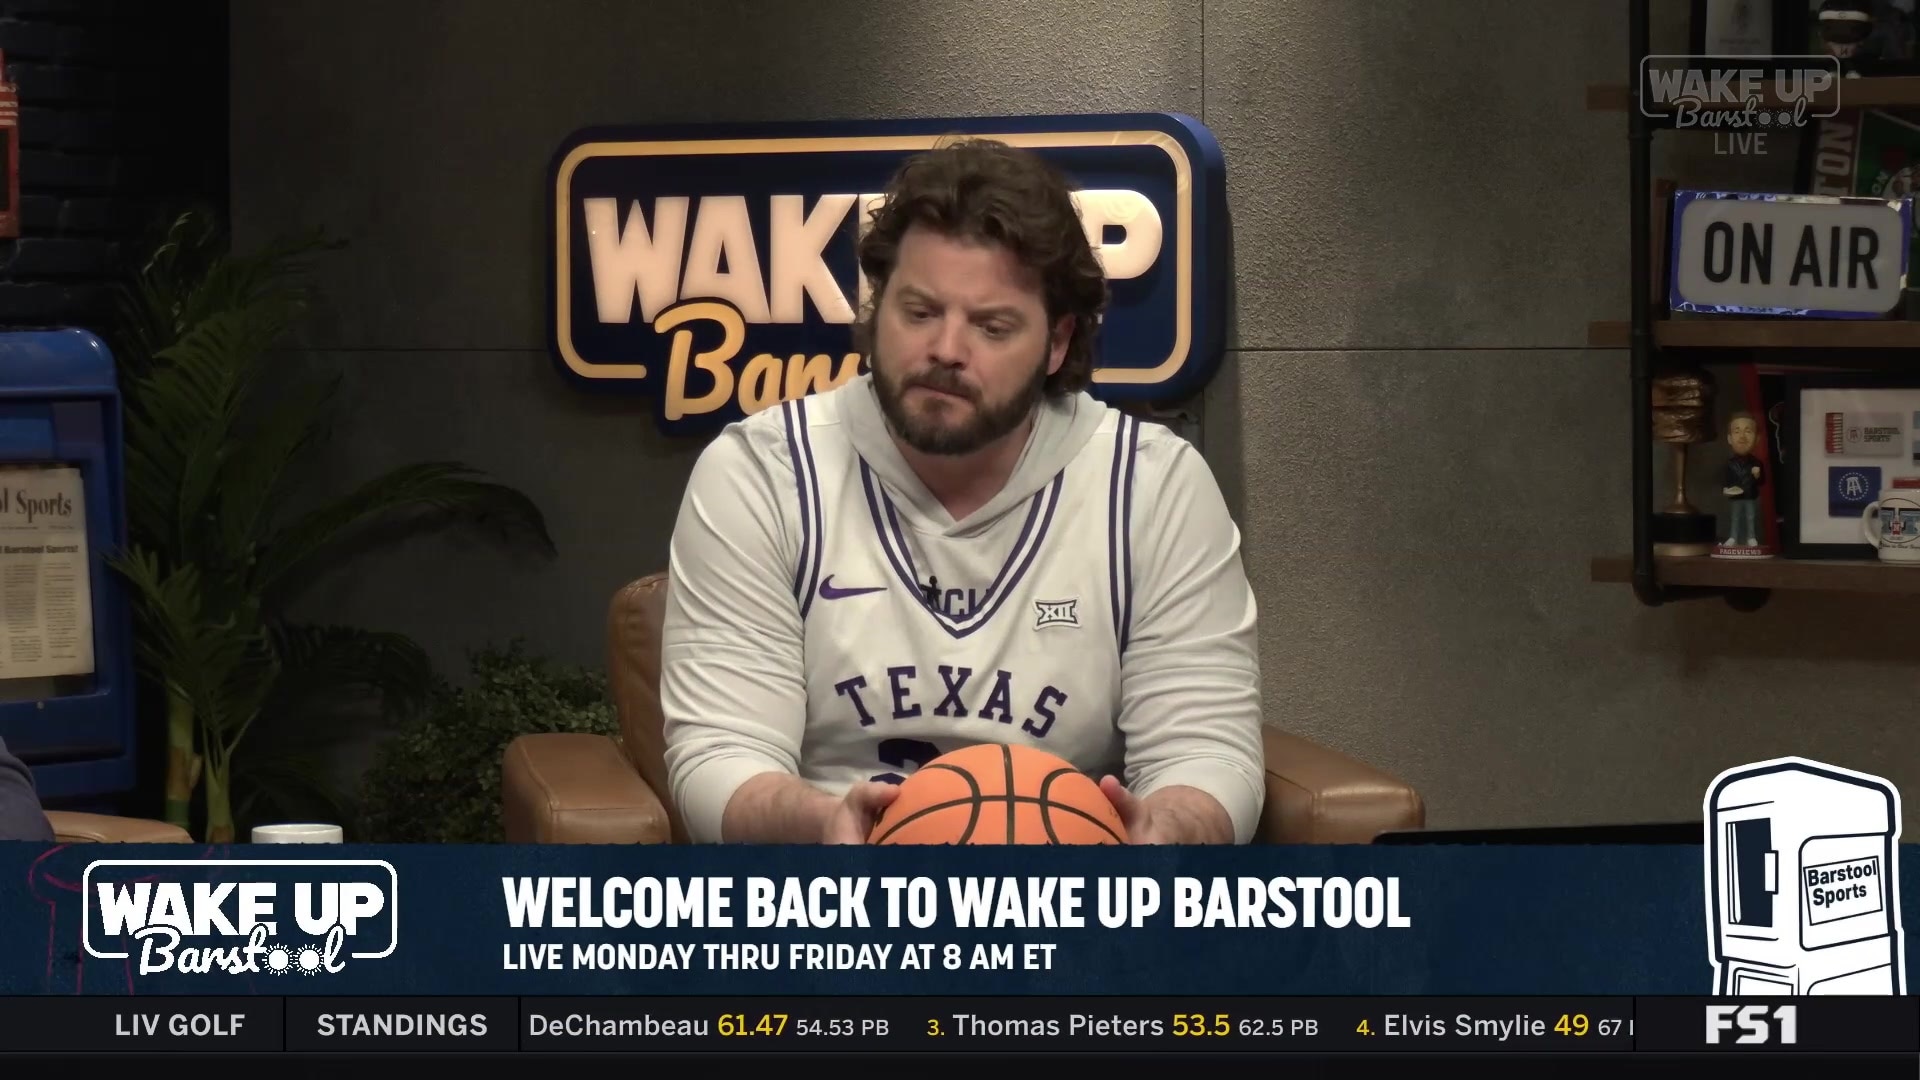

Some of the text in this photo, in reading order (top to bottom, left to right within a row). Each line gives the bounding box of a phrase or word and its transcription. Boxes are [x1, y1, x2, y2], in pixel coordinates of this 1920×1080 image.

[583, 193, 892, 325] WAK
[1703, 221, 1879, 290] ON AIR
[16, 489, 72, 523] Sports
[835, 665, 1068, 738] TEXAS
